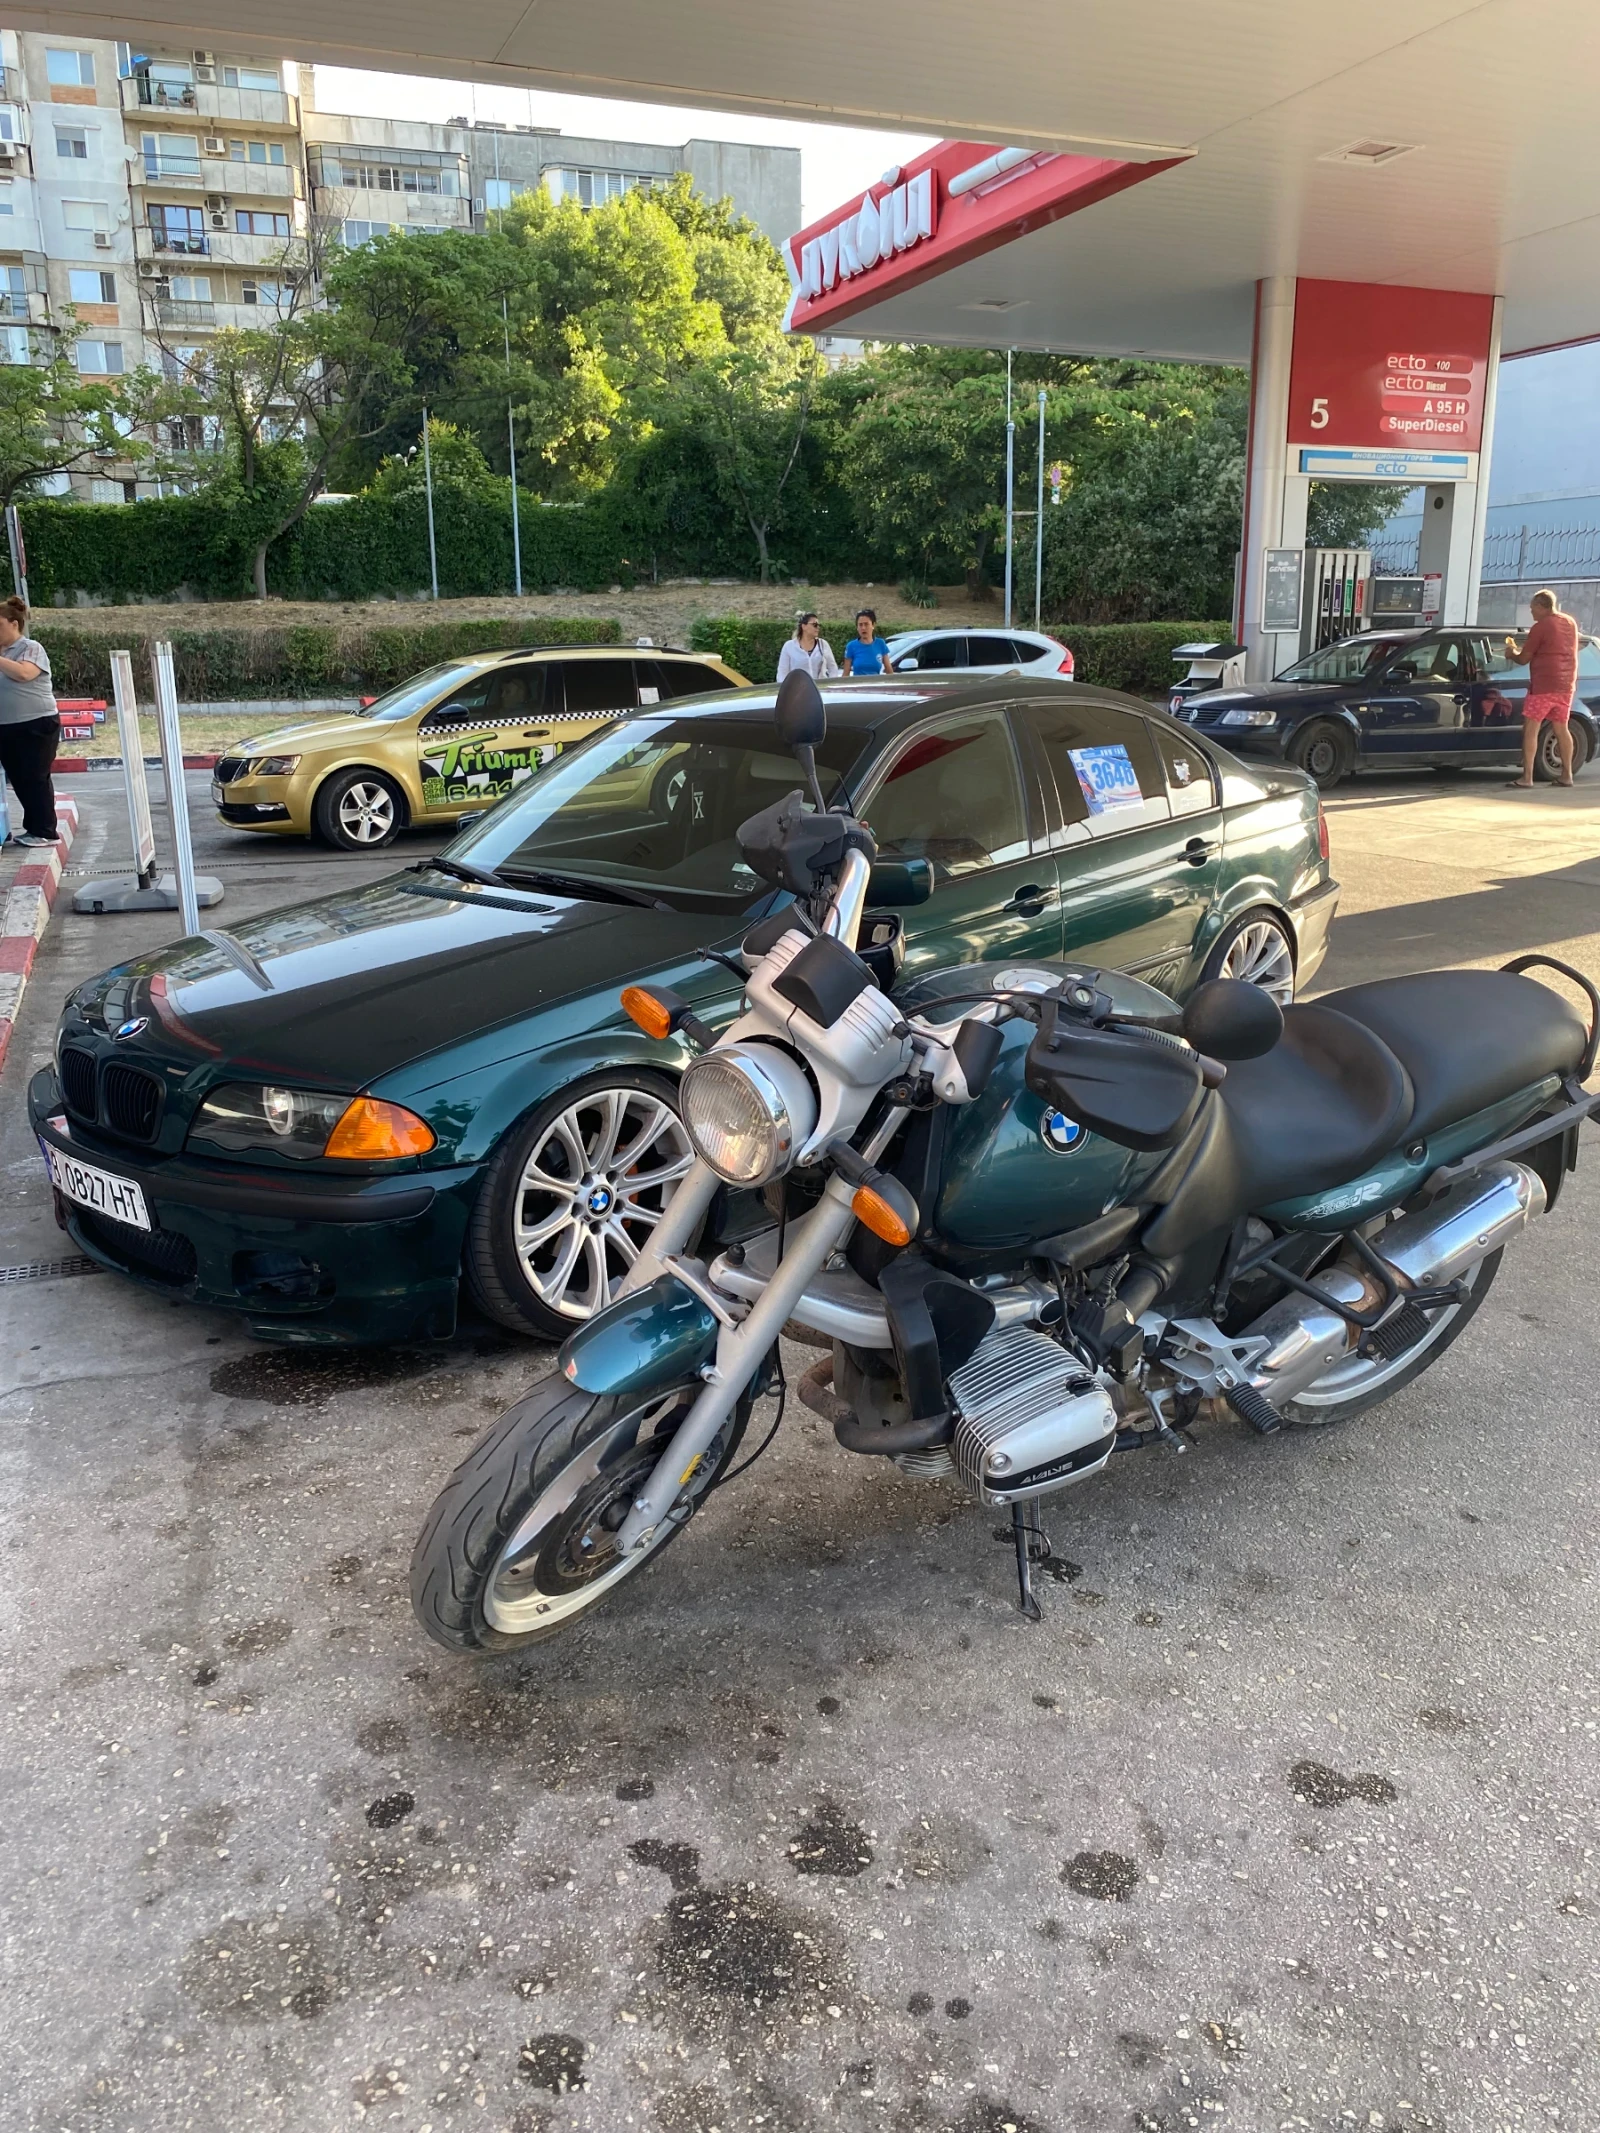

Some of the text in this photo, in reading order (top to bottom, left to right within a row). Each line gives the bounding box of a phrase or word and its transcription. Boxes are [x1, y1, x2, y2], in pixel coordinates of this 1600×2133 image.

[1387, 354, 1451, 371] ecto 100
[1385, 375, 1448, 393] ecto Diesel
[1310, 398, 1330, 430] 5
[1423, 400, 1466, 414] A 95 H
[1388, 416, 1465, 433] SuperDiesel
[1406, 454, 1434, 462] ГОРИВА
[1375, 461, 1407, 474] ecto
[424, 732, 543, 774] Triumf
[1091, 759, 1134, 790] 3646
[448, 780, 520, 801] 6444
[65, 1162, 105, 1209] 0827
[109, 1180, 139, 1221] HT
